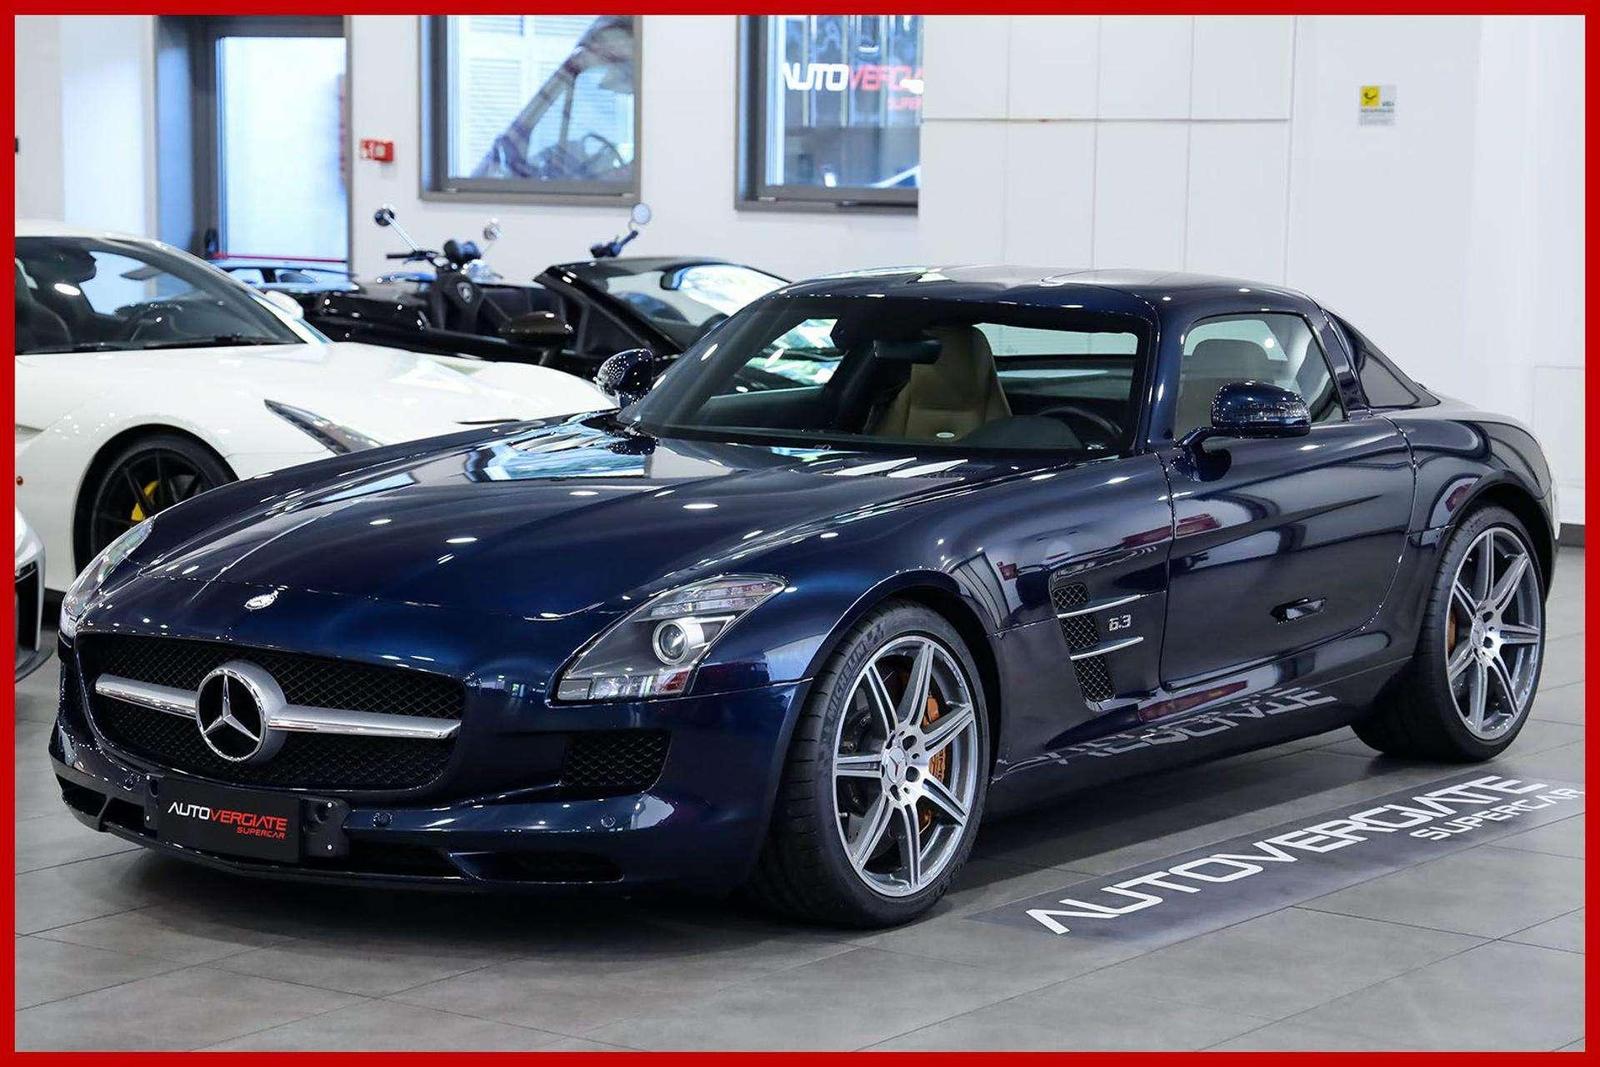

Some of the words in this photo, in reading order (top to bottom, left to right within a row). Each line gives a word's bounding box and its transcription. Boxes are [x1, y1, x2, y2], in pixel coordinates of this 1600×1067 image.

[1109, 614, 1131, 631] 6.3
[168, 801, 289, 832] AUTOVERGIATE
[1409, 788, 1584, 841] SUPERCAR
[236, 826, 286, 840] SUPERCAR
[1025, 776, 1548, 935] AUTOVERGIATE
